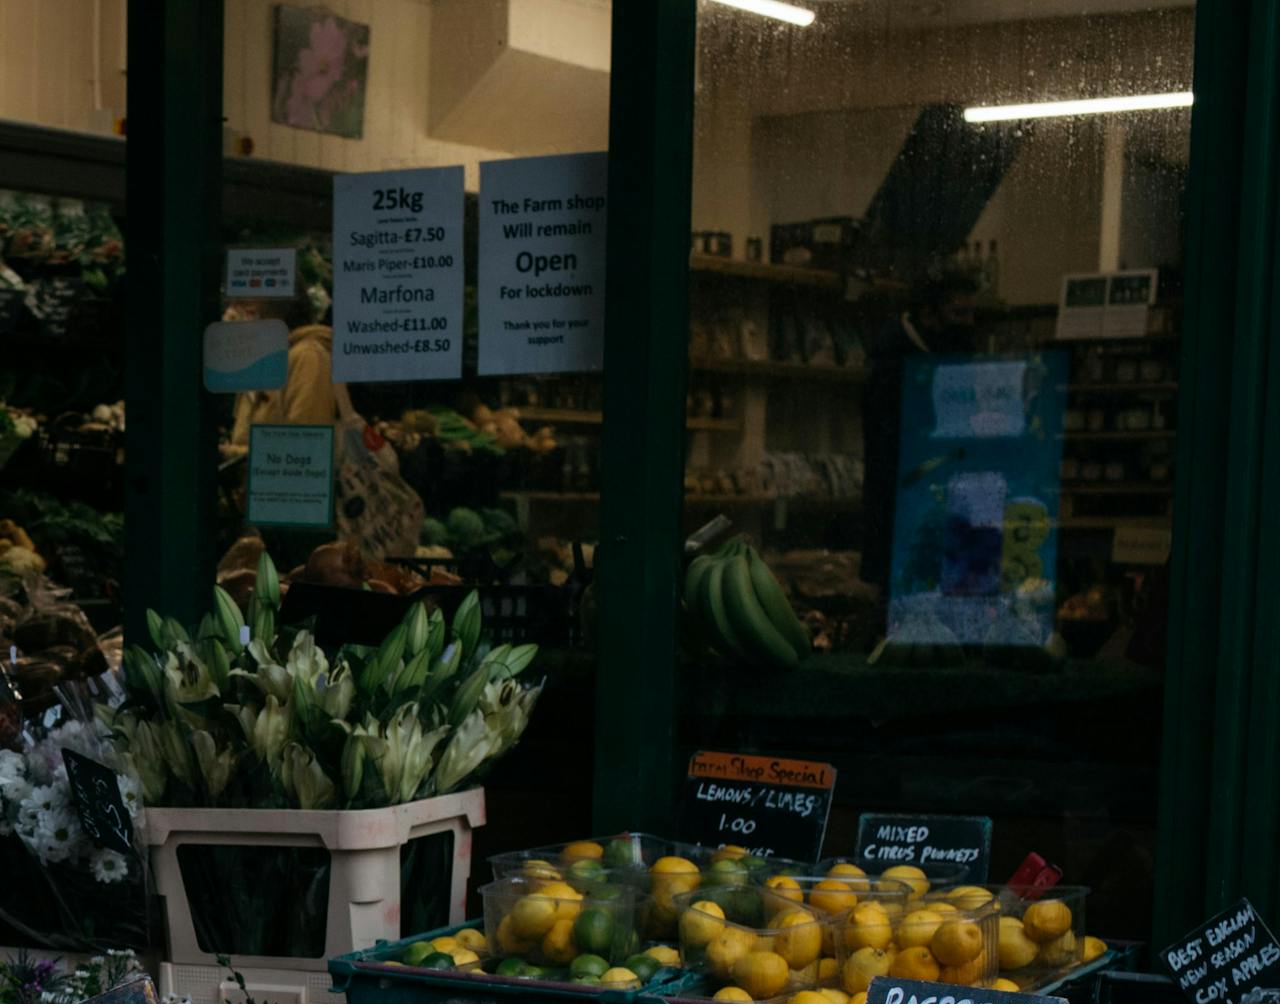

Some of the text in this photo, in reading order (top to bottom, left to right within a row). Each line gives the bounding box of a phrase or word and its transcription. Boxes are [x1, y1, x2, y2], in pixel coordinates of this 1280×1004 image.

[372, 188, 424, 212] 25kg
[492, 195, 605, 214] The Farm shop
[503, 220, 592, 238] Will remain
[343, 259, 376, 272] Maris
[516, 252, 577, 276] Open
[360, 285, 434, 304] Marfona
[500, 282, 592, 299] For lockdown
[503, 318, 589, 331] Thank you for your
[528, 334, 564, 346] support
[267, 454, 312, 468] No Dogs
[770, 761, 825, 784] Special
[718, 813, 756, 834] 1.00
[876, 824, 930, 843] MIXED
[864, 844, 980, 864] CITRUS PUNNETS
[1168, 937, 1202, 972] BEST
[1179, 925, 1256, 991] NEW SEASON
[1232, 942, 1280, 986] APPLES
